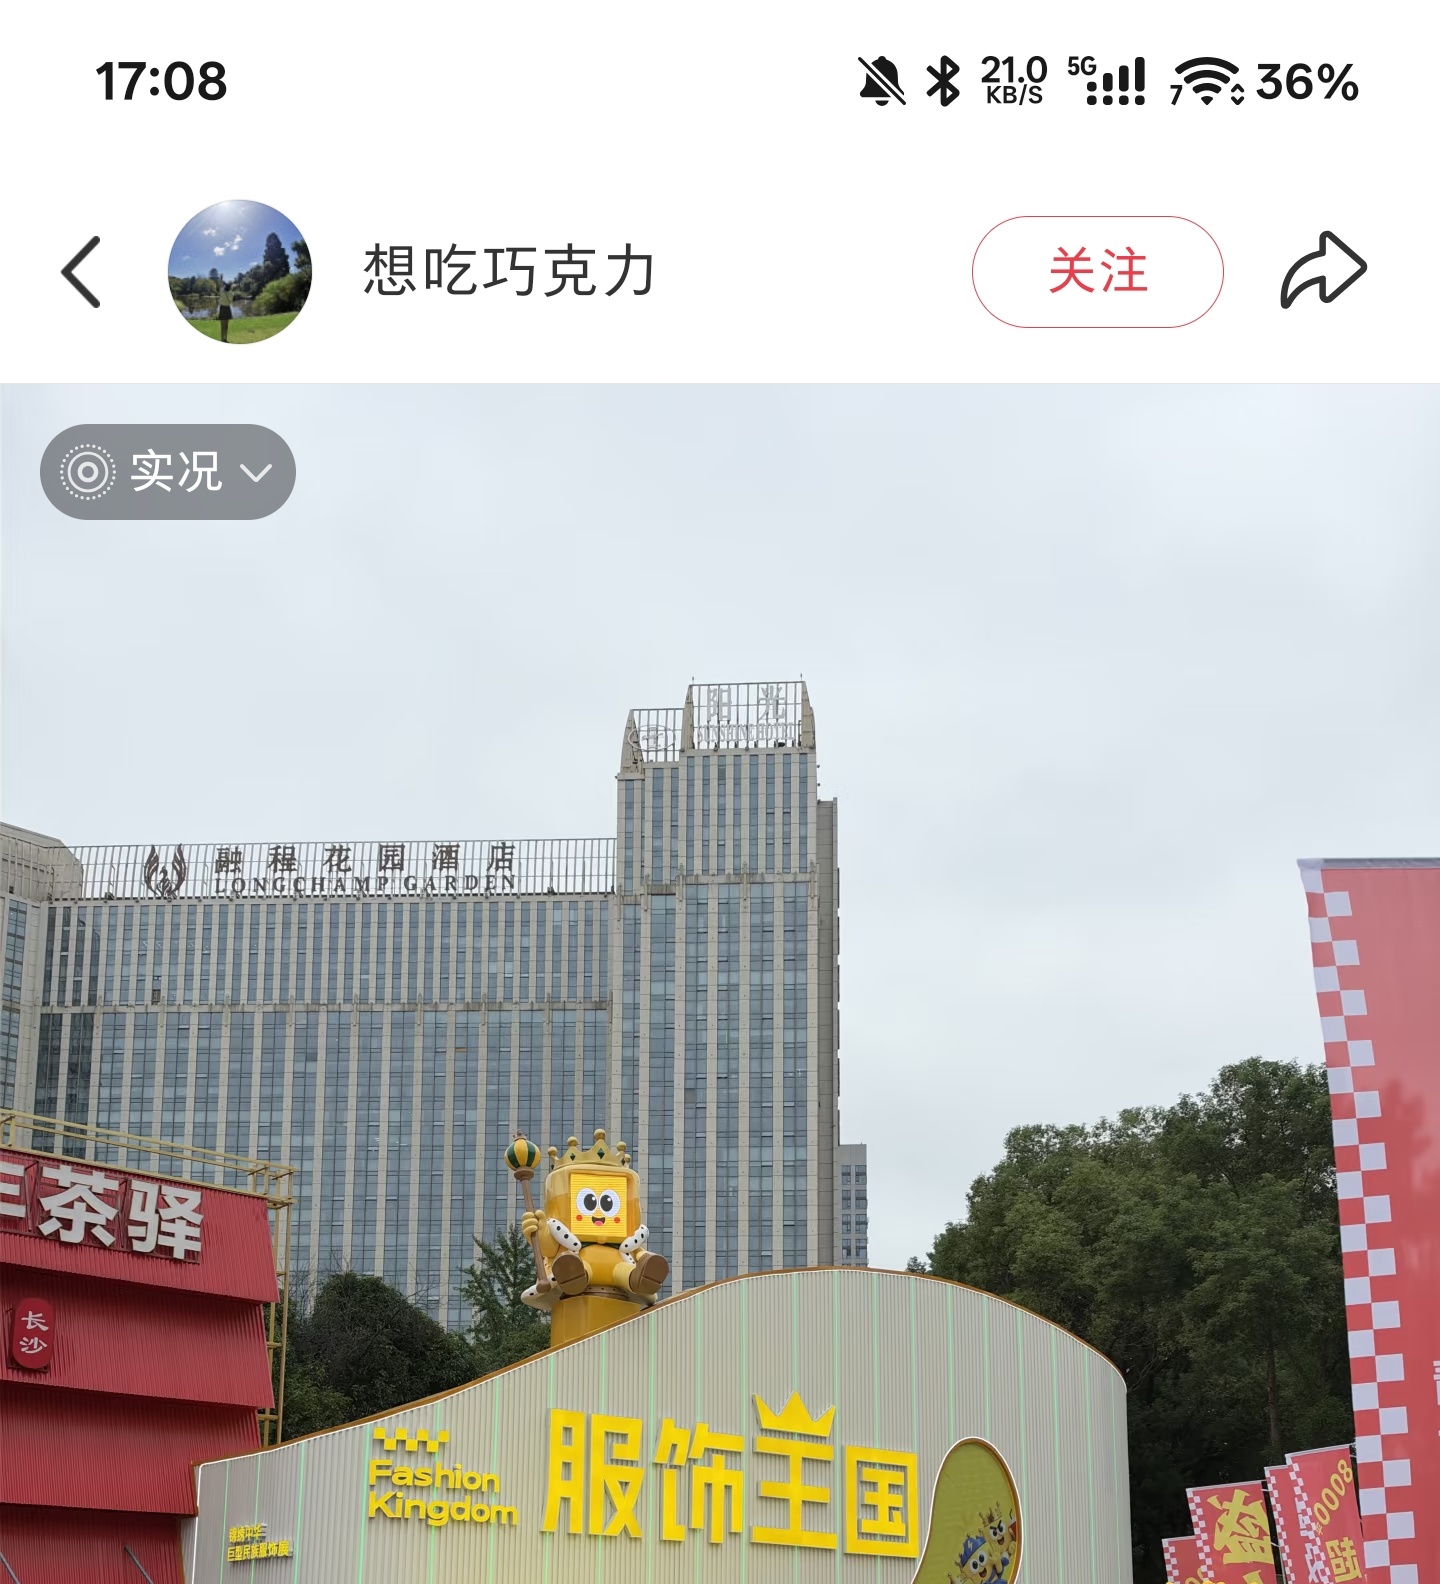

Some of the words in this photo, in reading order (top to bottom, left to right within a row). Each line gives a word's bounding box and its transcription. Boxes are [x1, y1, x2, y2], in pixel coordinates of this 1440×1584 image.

[706, 685, 785, 722] 阳光
[214, 842, 516, 874] 融程花园酒店
[214, 875, 390, 894] LONGCHAMP
[403, 874, 516, 892] GARDEN
[19, 1310, 49, 1356] 长沙
[369, 1459, 500, 1493] Fashion
[541, 1391, 919, 1558] 服饰王国
[368, 1491, 519, 1527] Kingdom
